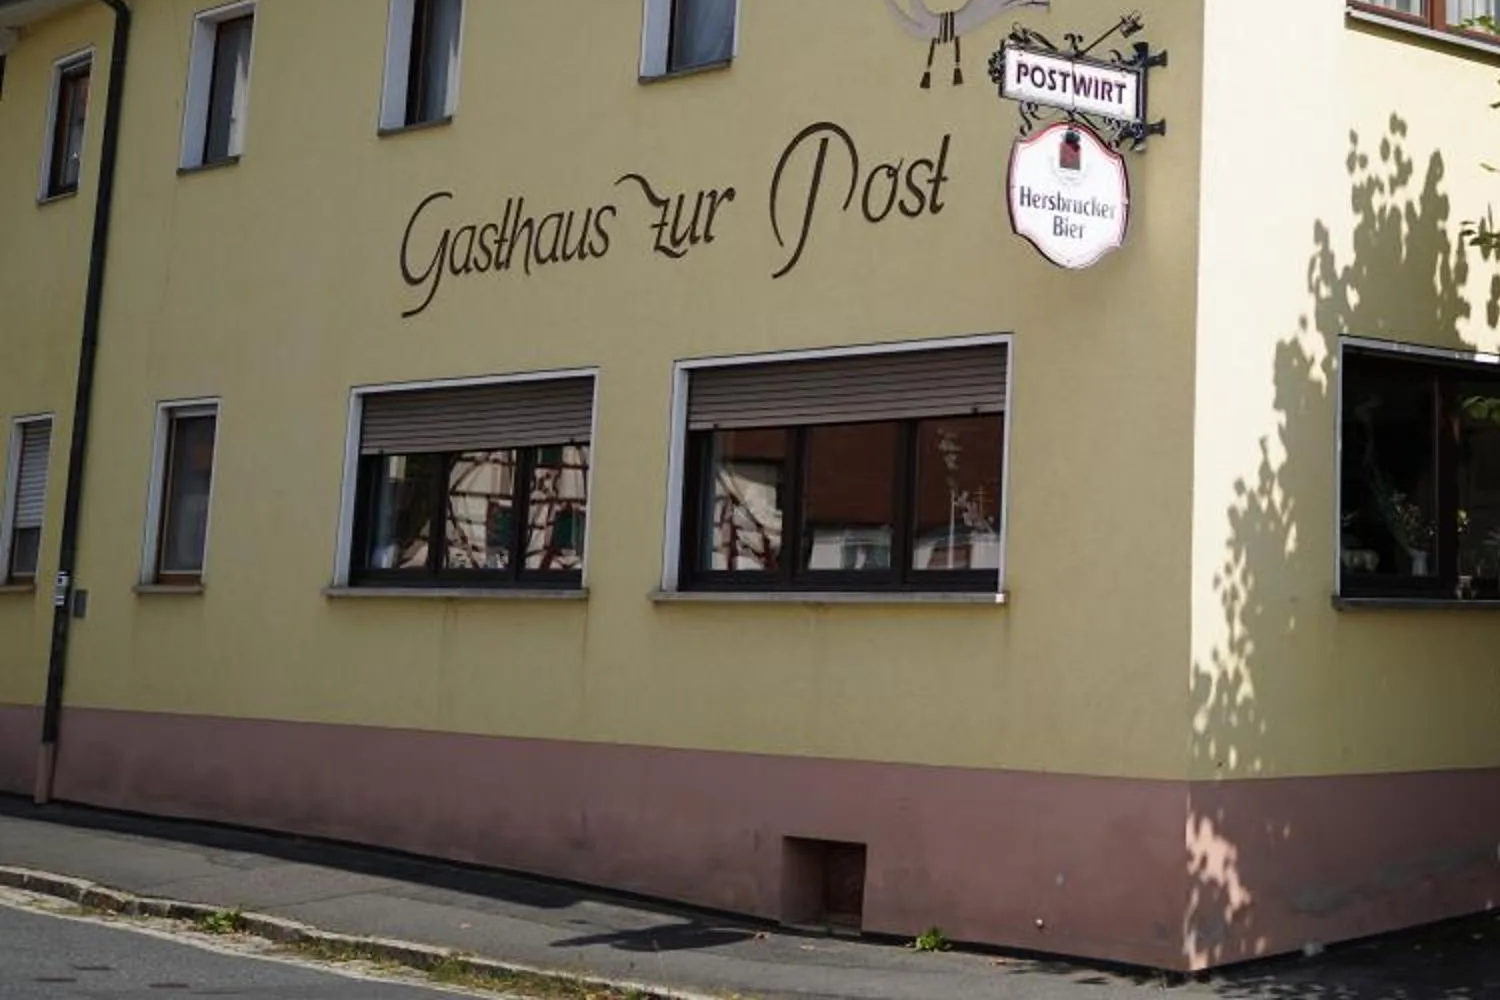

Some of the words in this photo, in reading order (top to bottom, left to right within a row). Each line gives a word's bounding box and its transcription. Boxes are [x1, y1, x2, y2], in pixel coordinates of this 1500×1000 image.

[1016, 62, 1127, 105] POSTWIRT
[400, 191, 617, 318] Gasthaus
[769, 121, 951, 279] Post
[1019, 184, 1116, 220] Hersbrucker
[1052, 215, 1086, 239] Bier
